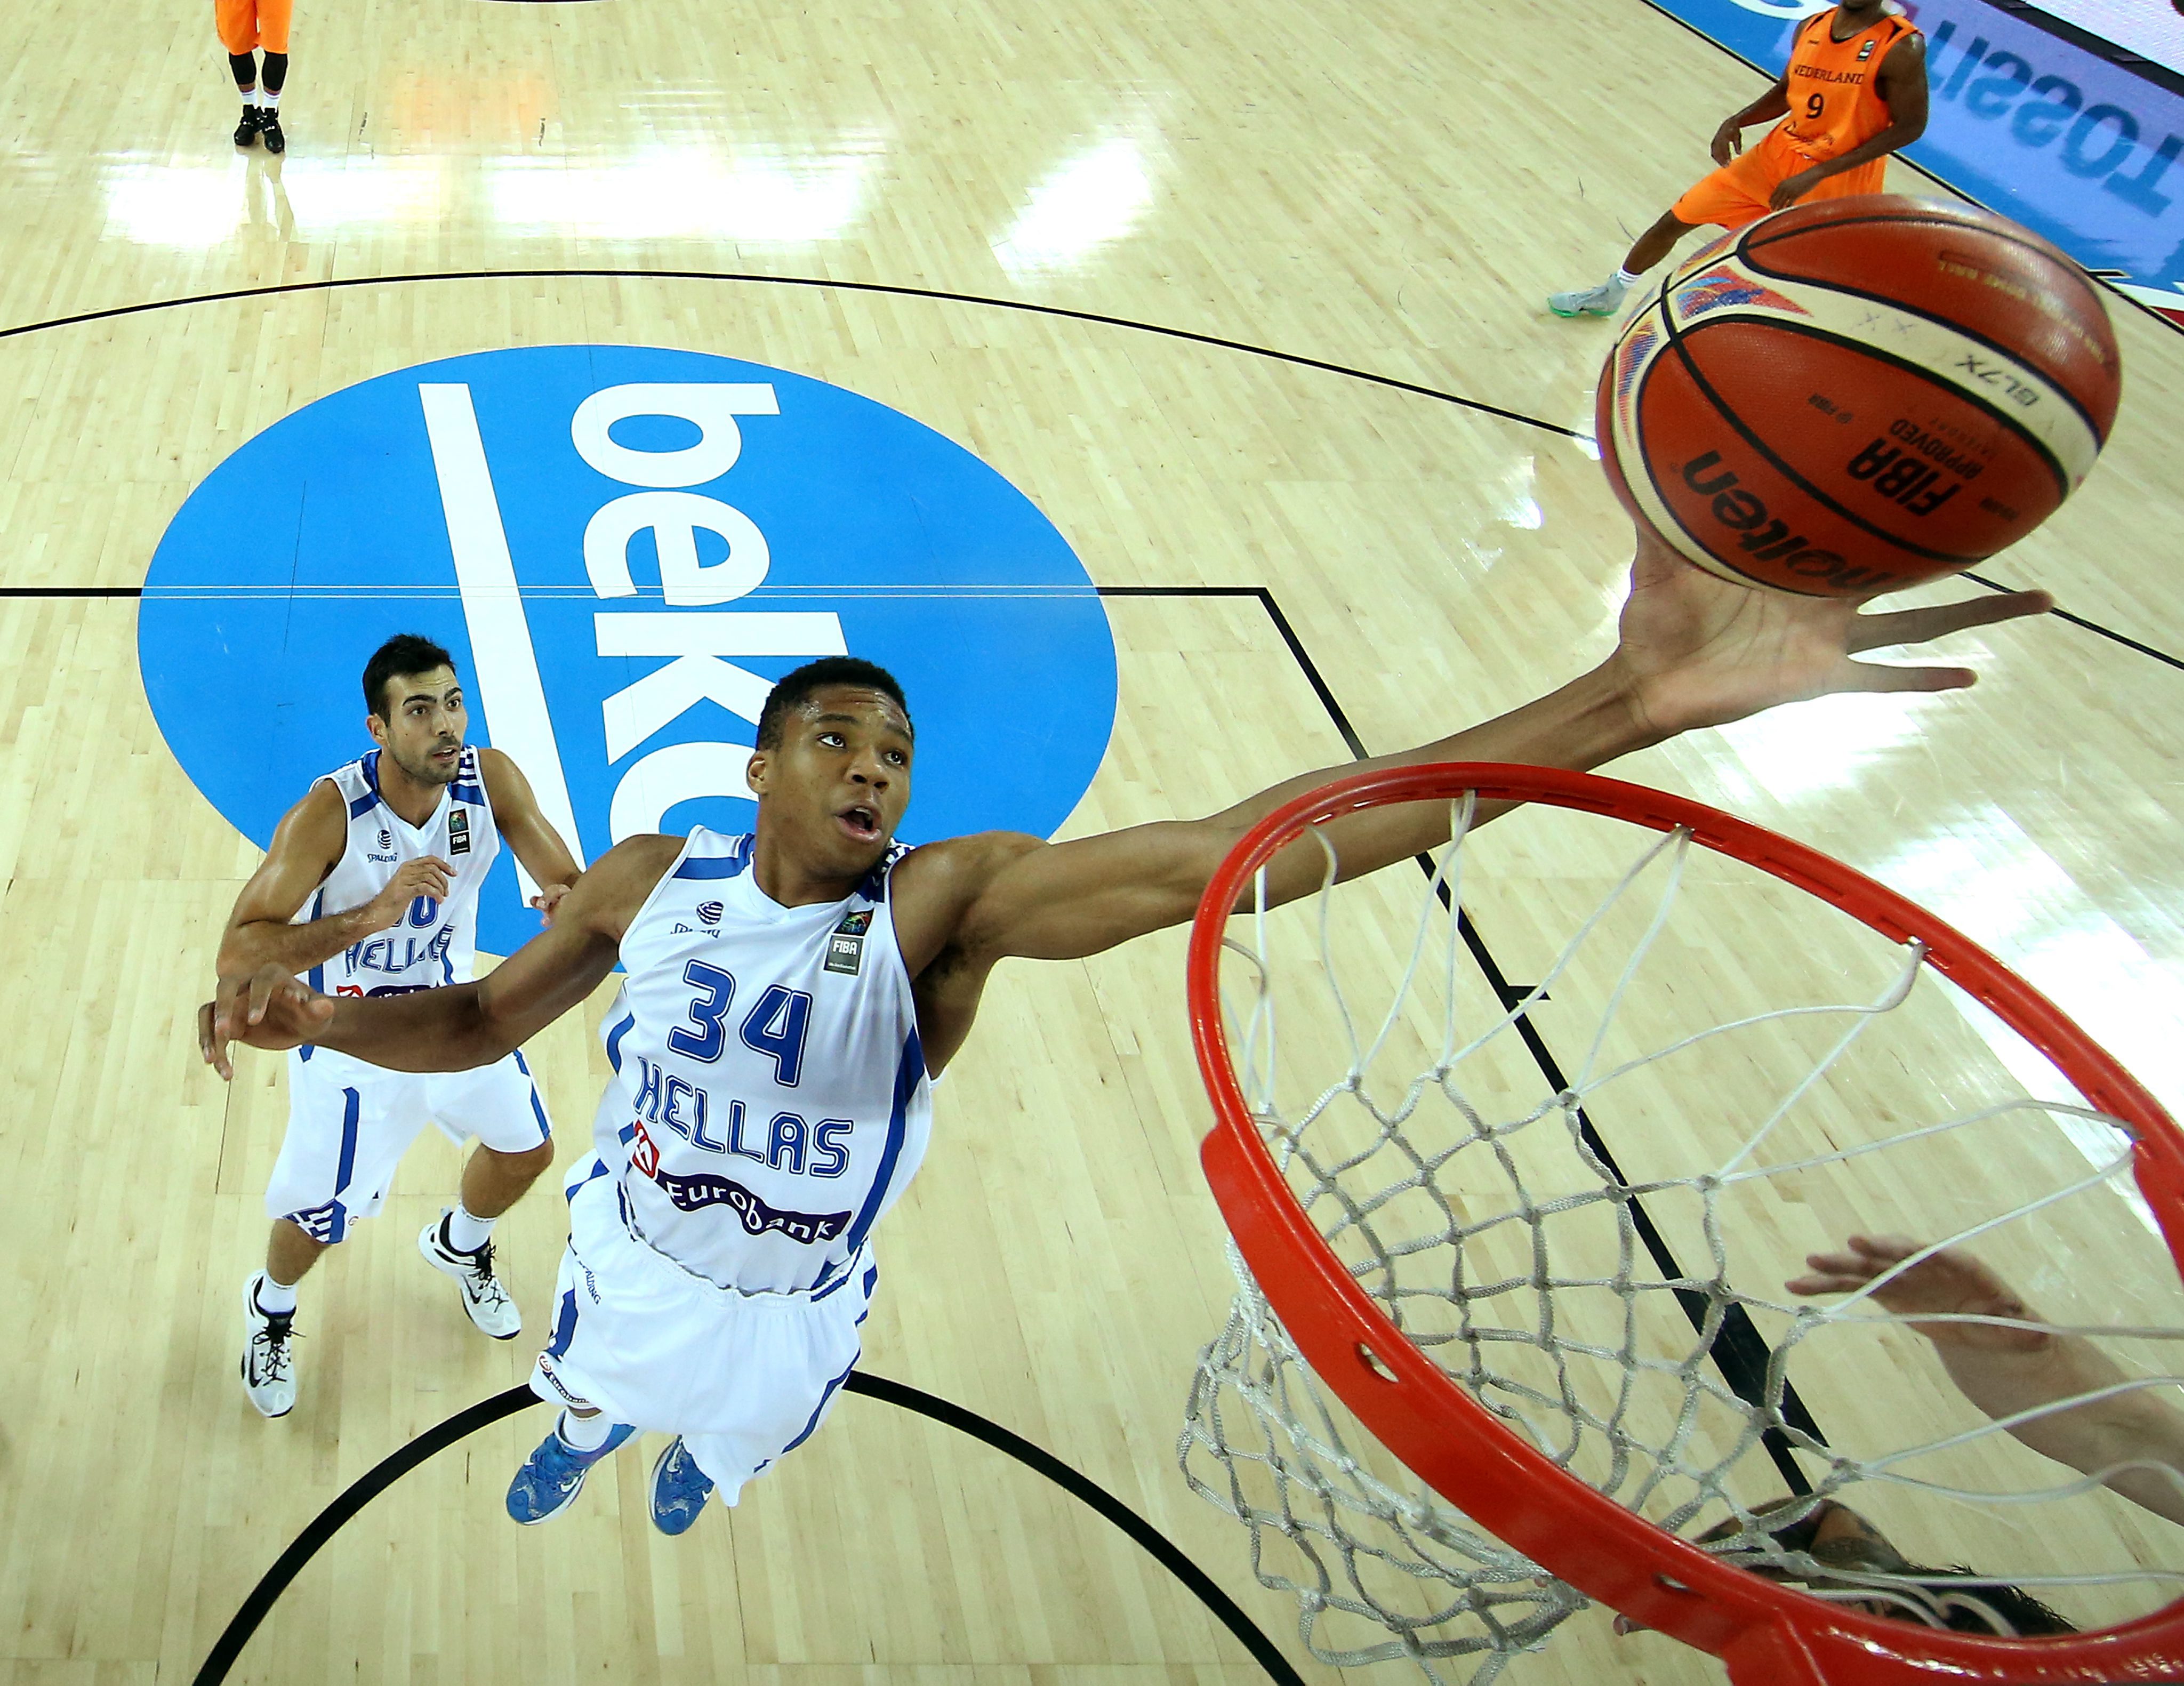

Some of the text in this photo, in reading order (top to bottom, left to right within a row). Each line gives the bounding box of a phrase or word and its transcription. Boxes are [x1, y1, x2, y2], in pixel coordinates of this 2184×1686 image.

[1806, 93, 1824, 119] 9
[1847, 437, 1964, 517] FIBA
[1890, 418, 1984, 480] APPROVED
[832, 940, 857, 956] FIBA
[667, 959, 814, 1088] 34
[633, 1056, 854, 1178] HELLAS
[549, 1374, 587, 1403] Euroban
